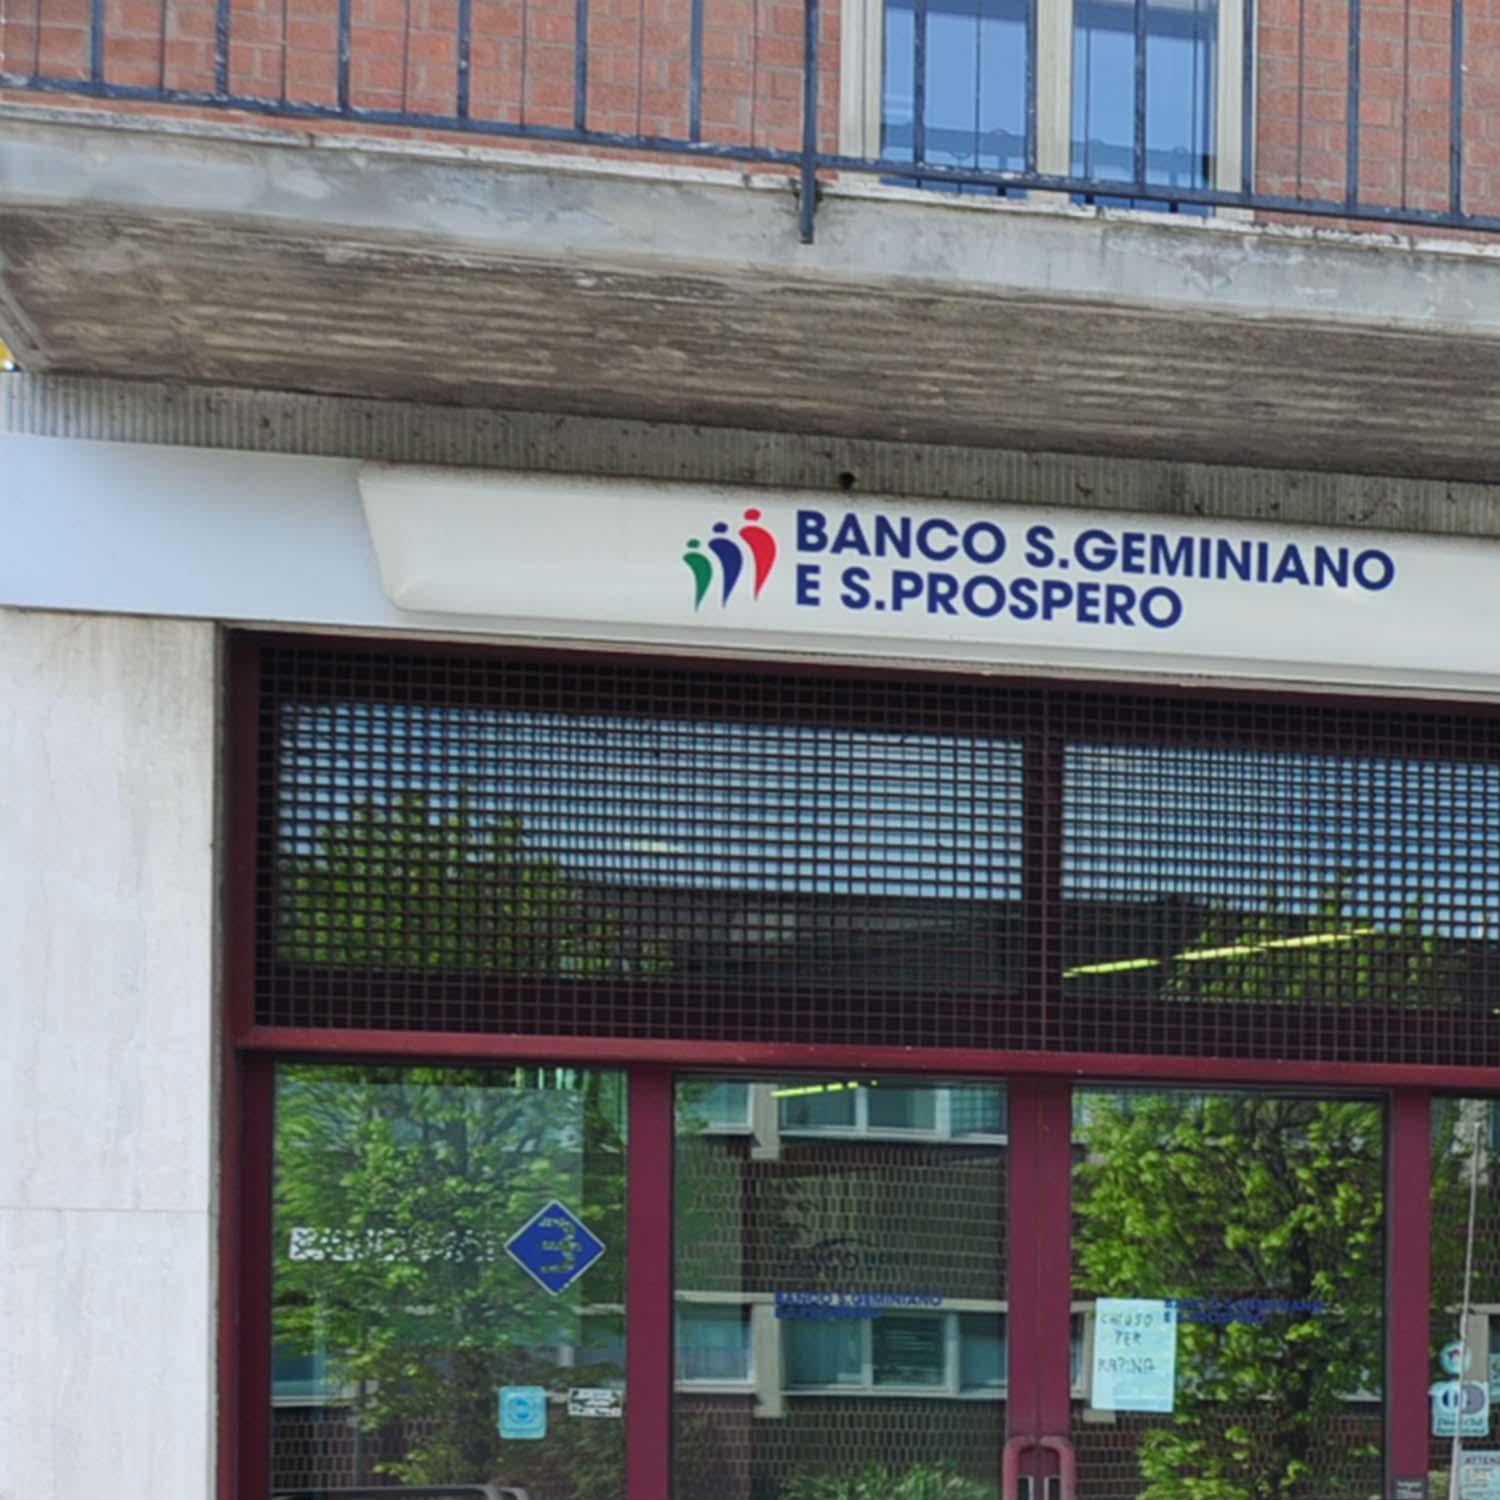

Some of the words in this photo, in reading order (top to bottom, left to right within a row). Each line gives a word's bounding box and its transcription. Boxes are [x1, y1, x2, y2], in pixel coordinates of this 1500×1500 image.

[796, 509, 1006, 563] BANCO
[1025, 528, 1396, 591] S.GEMINIANO
[796, 564, 820, 606] E
[841, 566, 1183, 629] S.PROSPERO
[1114, 1330, 1142, 1347] PER
